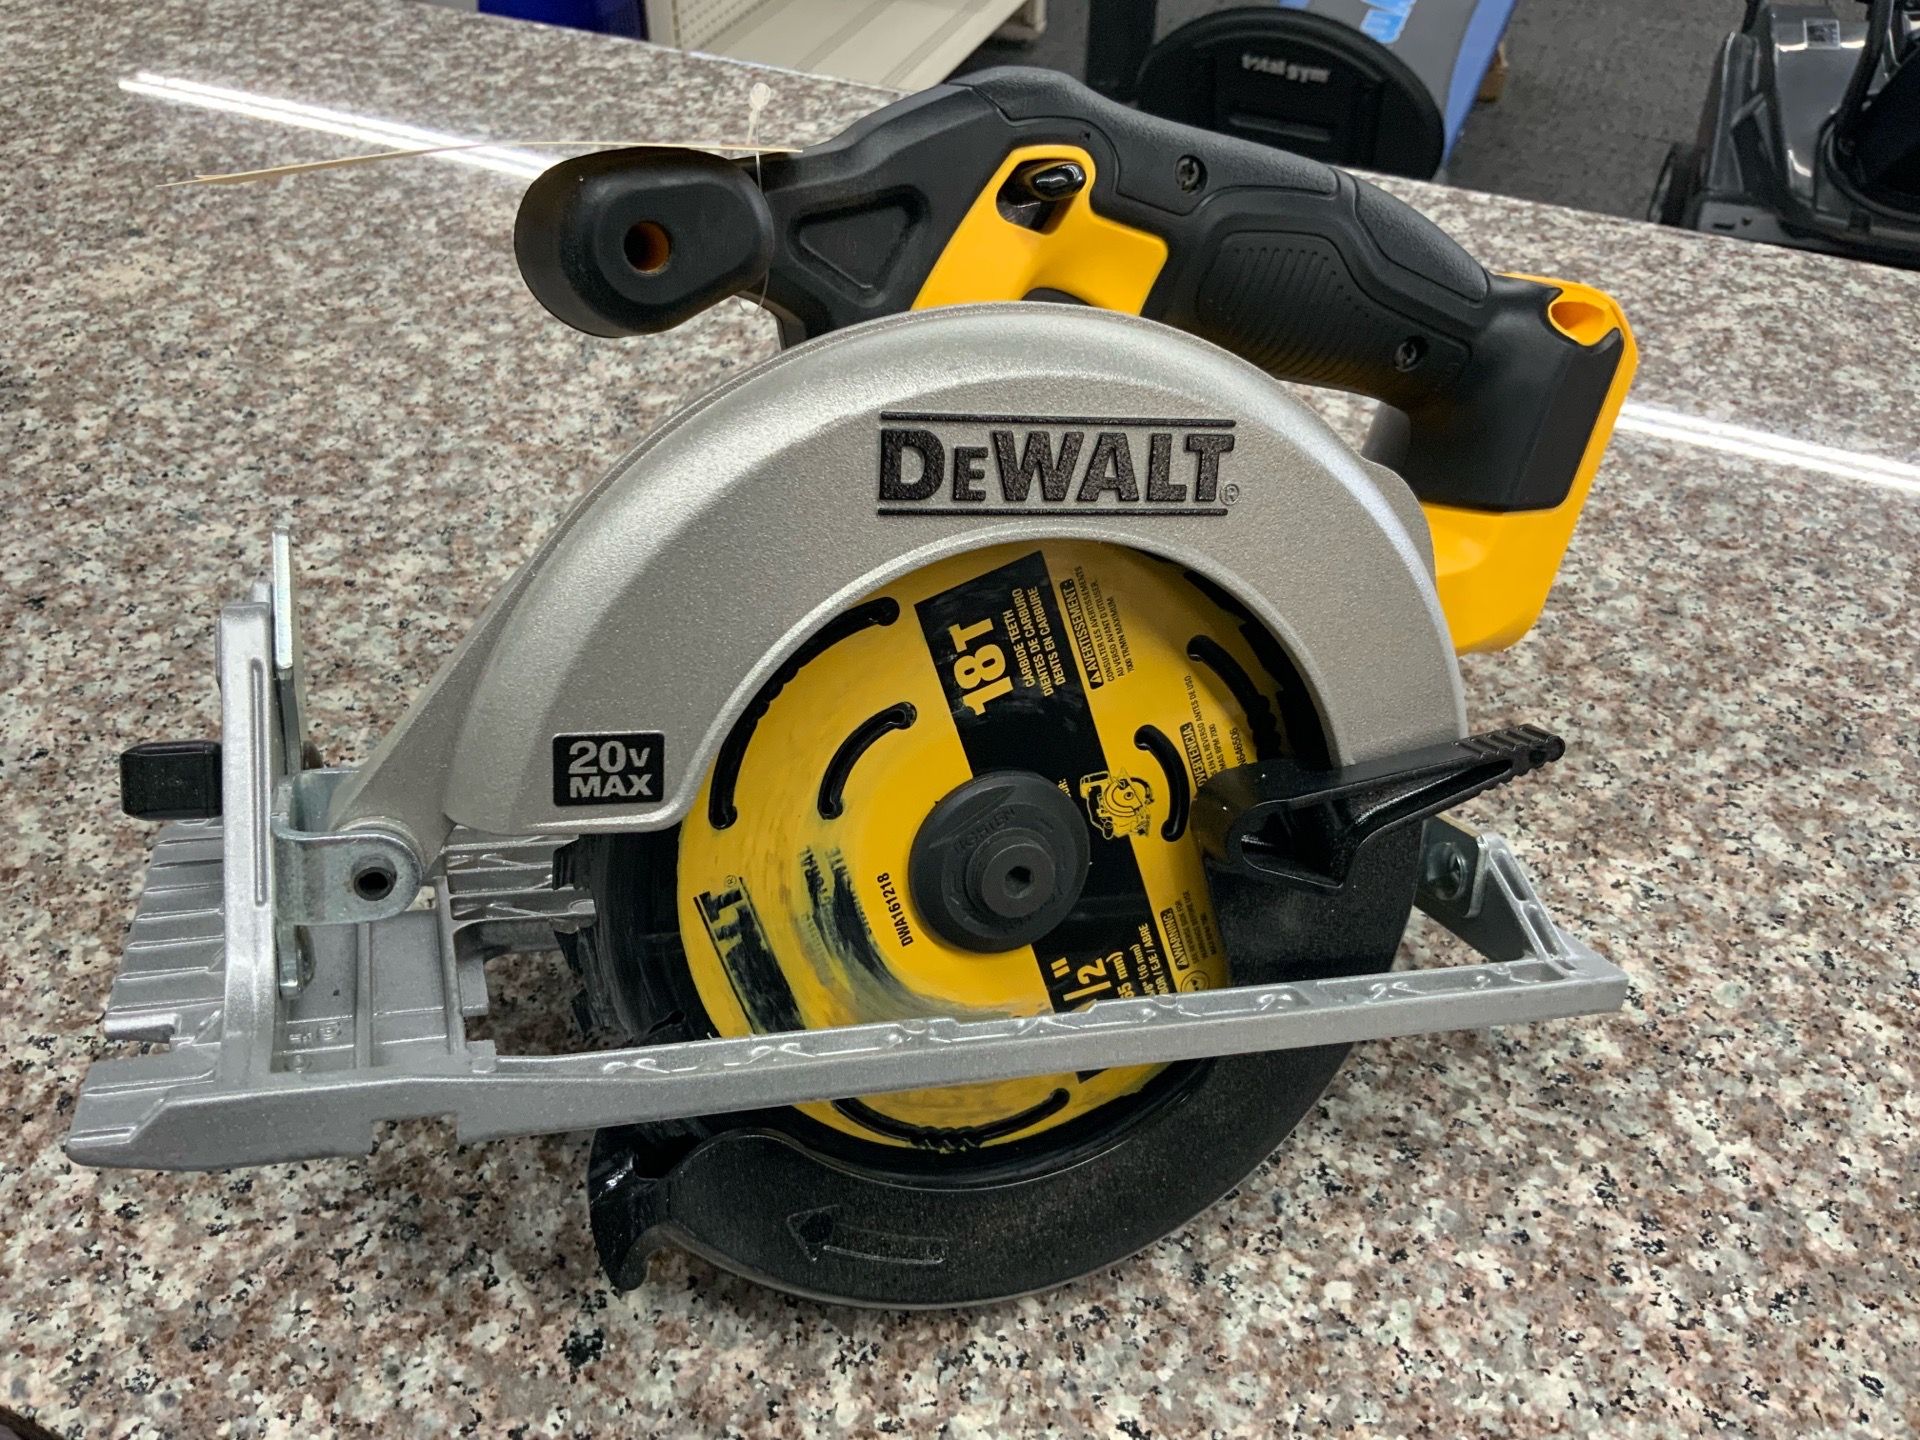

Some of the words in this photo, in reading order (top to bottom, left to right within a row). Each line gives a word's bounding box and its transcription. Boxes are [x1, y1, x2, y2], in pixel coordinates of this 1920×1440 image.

[878, 428, 1235, 502] DEWALT
[1012, 588, 1036, 638] CARBURO
[1027, 586, 1051, 636] CARBURE
[1074, 566, 1099, 629] AVERTISSEMENTS
[1003, 609, 1022, 642] TEETH
[1093, 629, 1103, 642] LES
[1102, 620, 1114, 644] AVANT
[1028, 638, 1041, 653] DE
[1042, 636, 1055, 651] EN
[1109, 644, 1121, 667] VERSO
[948, 618, 1013, 715] 18T
[1013, 642, 1036, 688] CARBIDE
[1032, 654, 1055, 697] DIENTES
[1047, 651, 1066, 686] DENTS
[1097, 642, 1115, 683] CONSULTER
[1115, 666, 1125, 677] AU
[1190, 699, 1202, 722] ANTES
[1197, 723, 1210, 752] REVERSO
[1182, 725, 1207, 787] DVERTENCIA:
[1208, 760, 1215, 770] EN
[570, 774, 653, 798] MAX
[877, 873, 914, 947] DWA161218
[1136, 964, 1149, 980] (16
[1148, 953, 1161, 971] EJE
